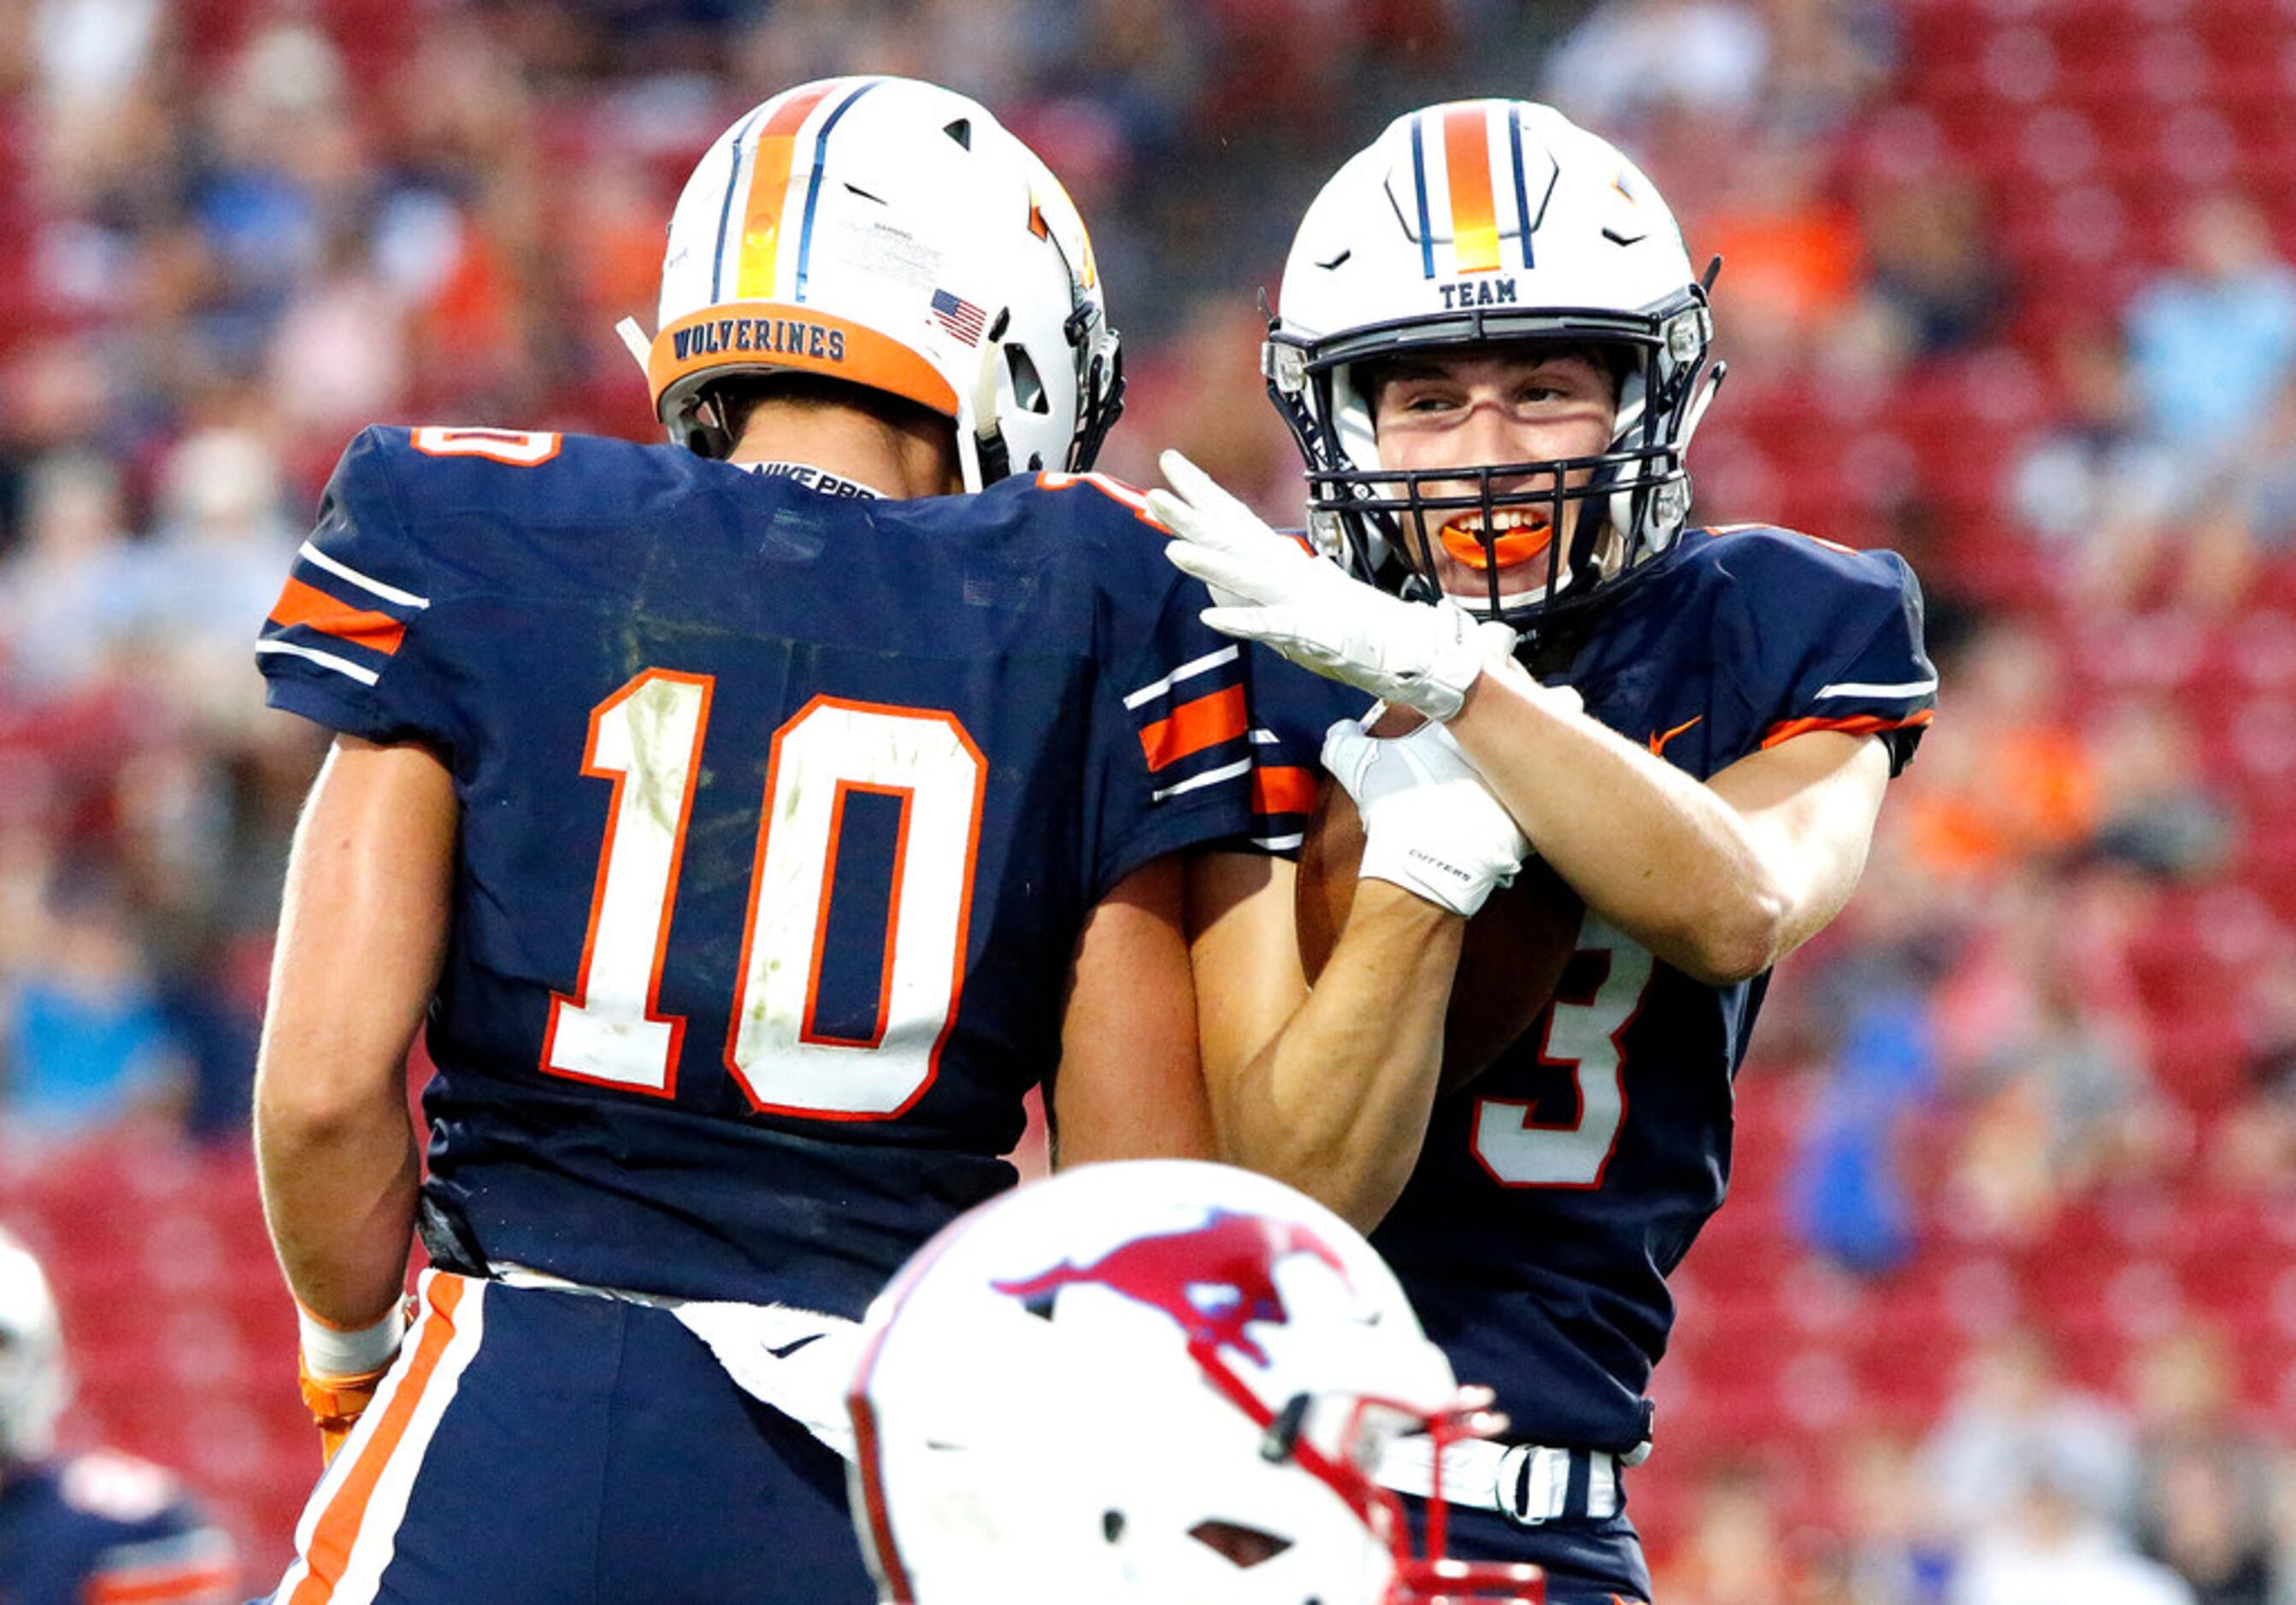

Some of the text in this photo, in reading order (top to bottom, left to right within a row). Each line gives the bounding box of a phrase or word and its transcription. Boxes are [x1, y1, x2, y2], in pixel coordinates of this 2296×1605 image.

[1439, 278, 1517, 309] TEAM
[674, 319, 845, 362] WOLVERINES
[752, 462, 816, 483] NIKE
[539, 667, 989, 1121] 10
[1469, 908, 1657, 1190] 3
